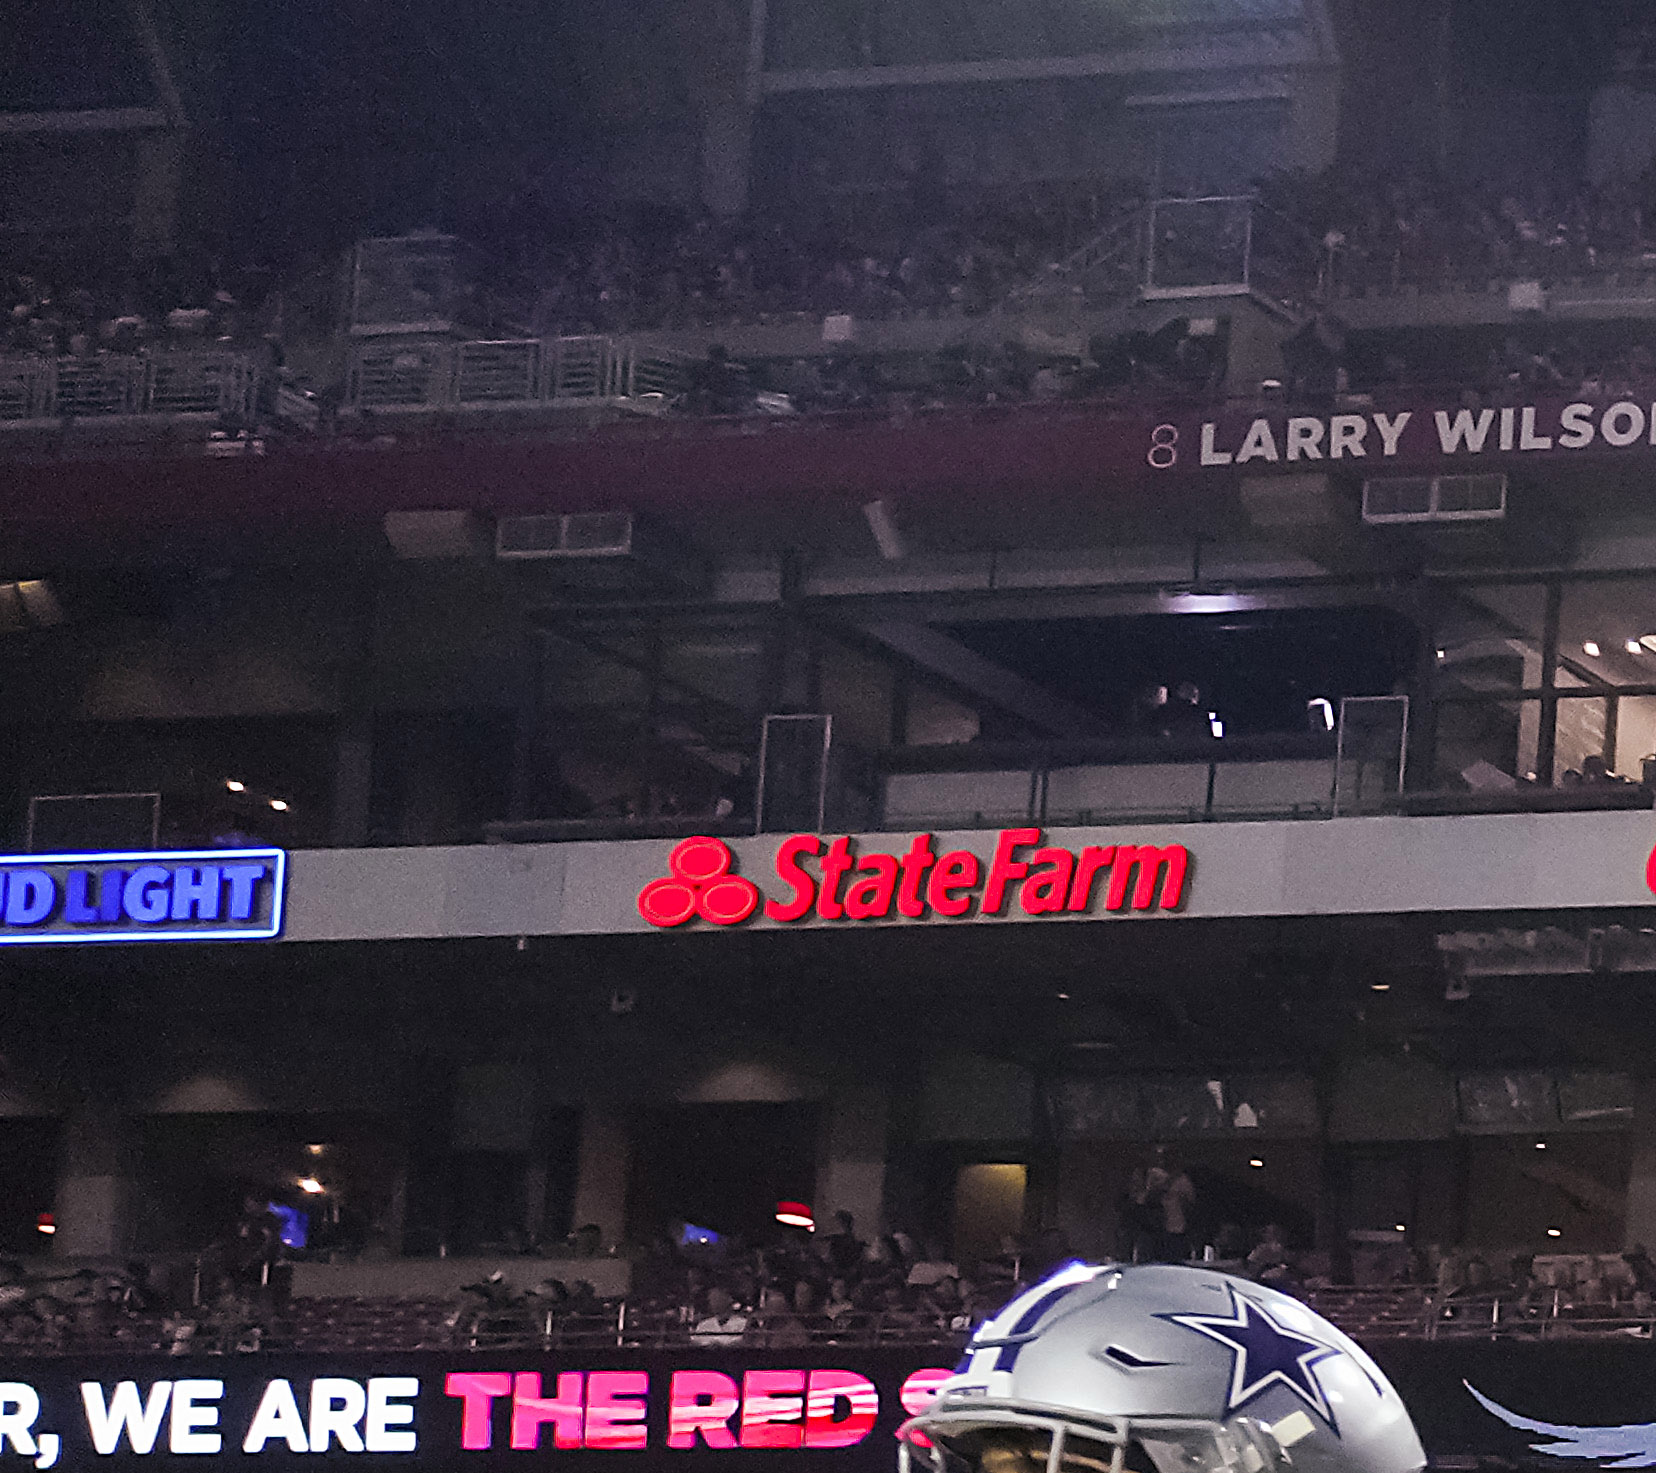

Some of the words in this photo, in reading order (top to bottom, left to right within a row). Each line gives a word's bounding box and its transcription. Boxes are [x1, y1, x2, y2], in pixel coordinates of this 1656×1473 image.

[1147, 424, 1178, 469] 8
[1199, 412, 1413, 467] LARRY
[63, 866, 265, 923] LIGHT
[80, 1379, 223, 1455] WE
[243, 1377, 419, 1453] ARE
[444, 1369, 649, 1449] THE
[667, 1368, 880, 1449] RED
